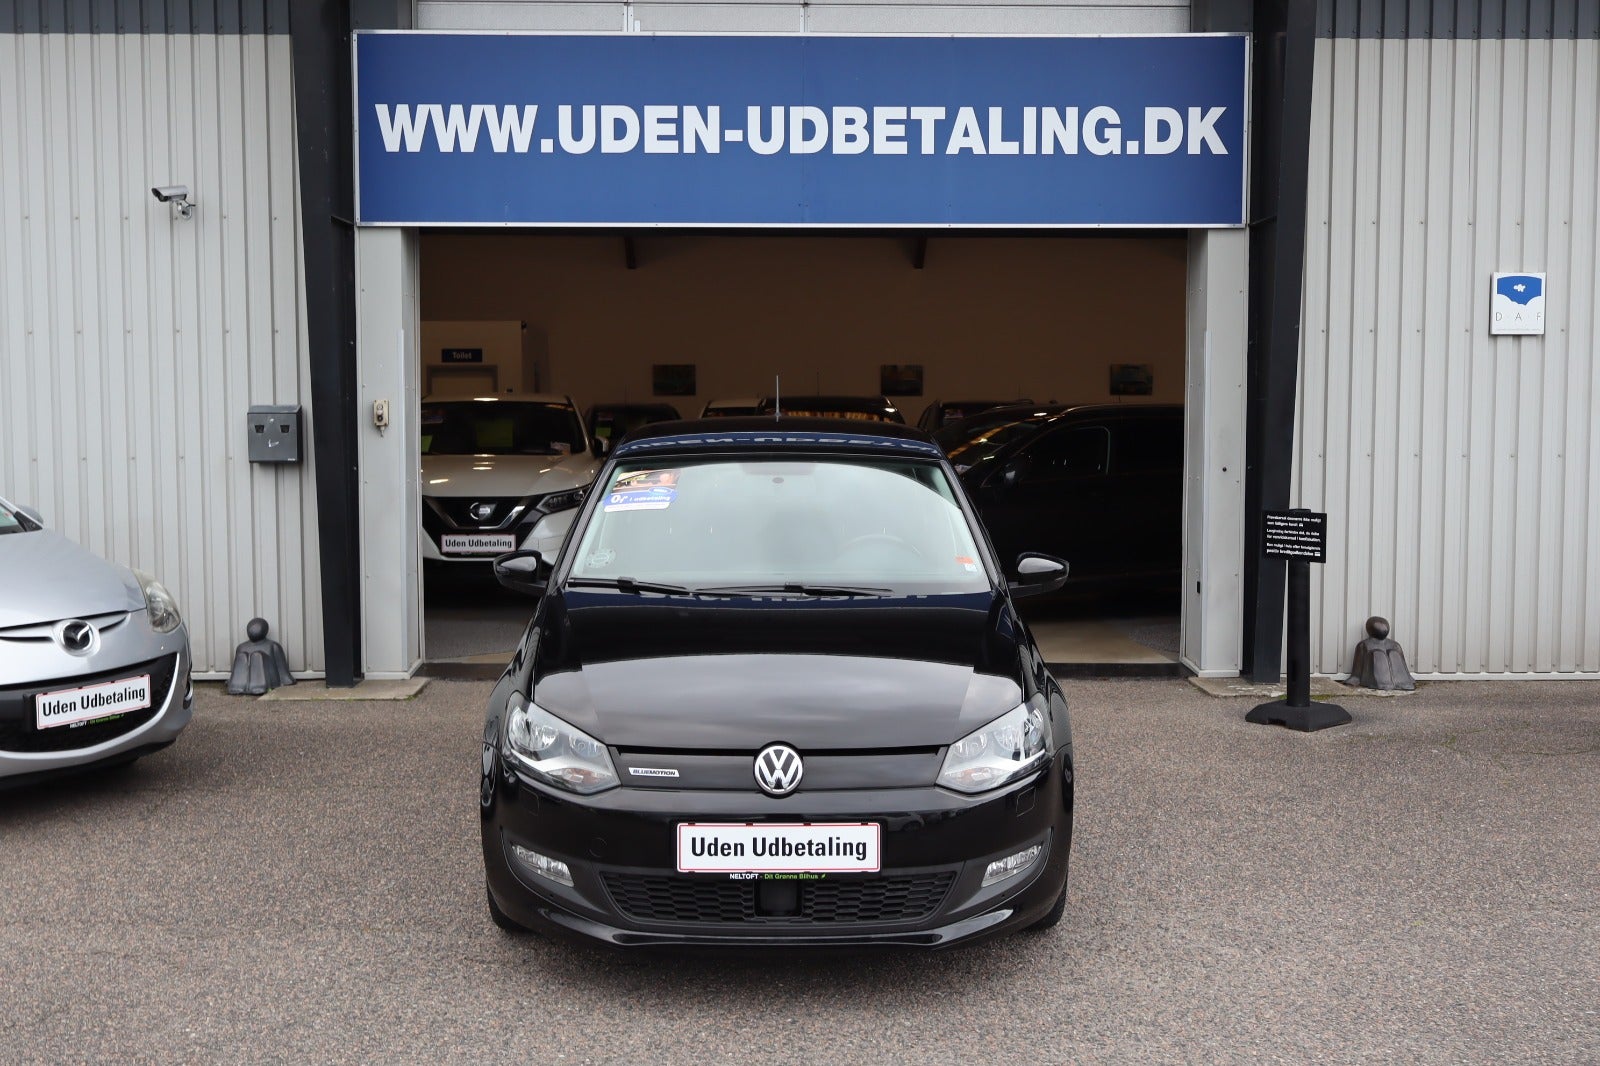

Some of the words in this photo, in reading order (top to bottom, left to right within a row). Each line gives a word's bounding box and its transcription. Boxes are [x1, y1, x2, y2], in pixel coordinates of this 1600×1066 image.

[374, 103, 1229, 156] WWW.UDEN-UDBETALING.DK
[445, 539, 466, 547] Uden
[468, 539, 512, 548] Udbetaling
[42, 700, 77, 717] Uden
[80, 687, 146, 710] Udbetaling
[691, 837, 745, 857] Uden
[752, 837, 867, 861] Udbetaling
